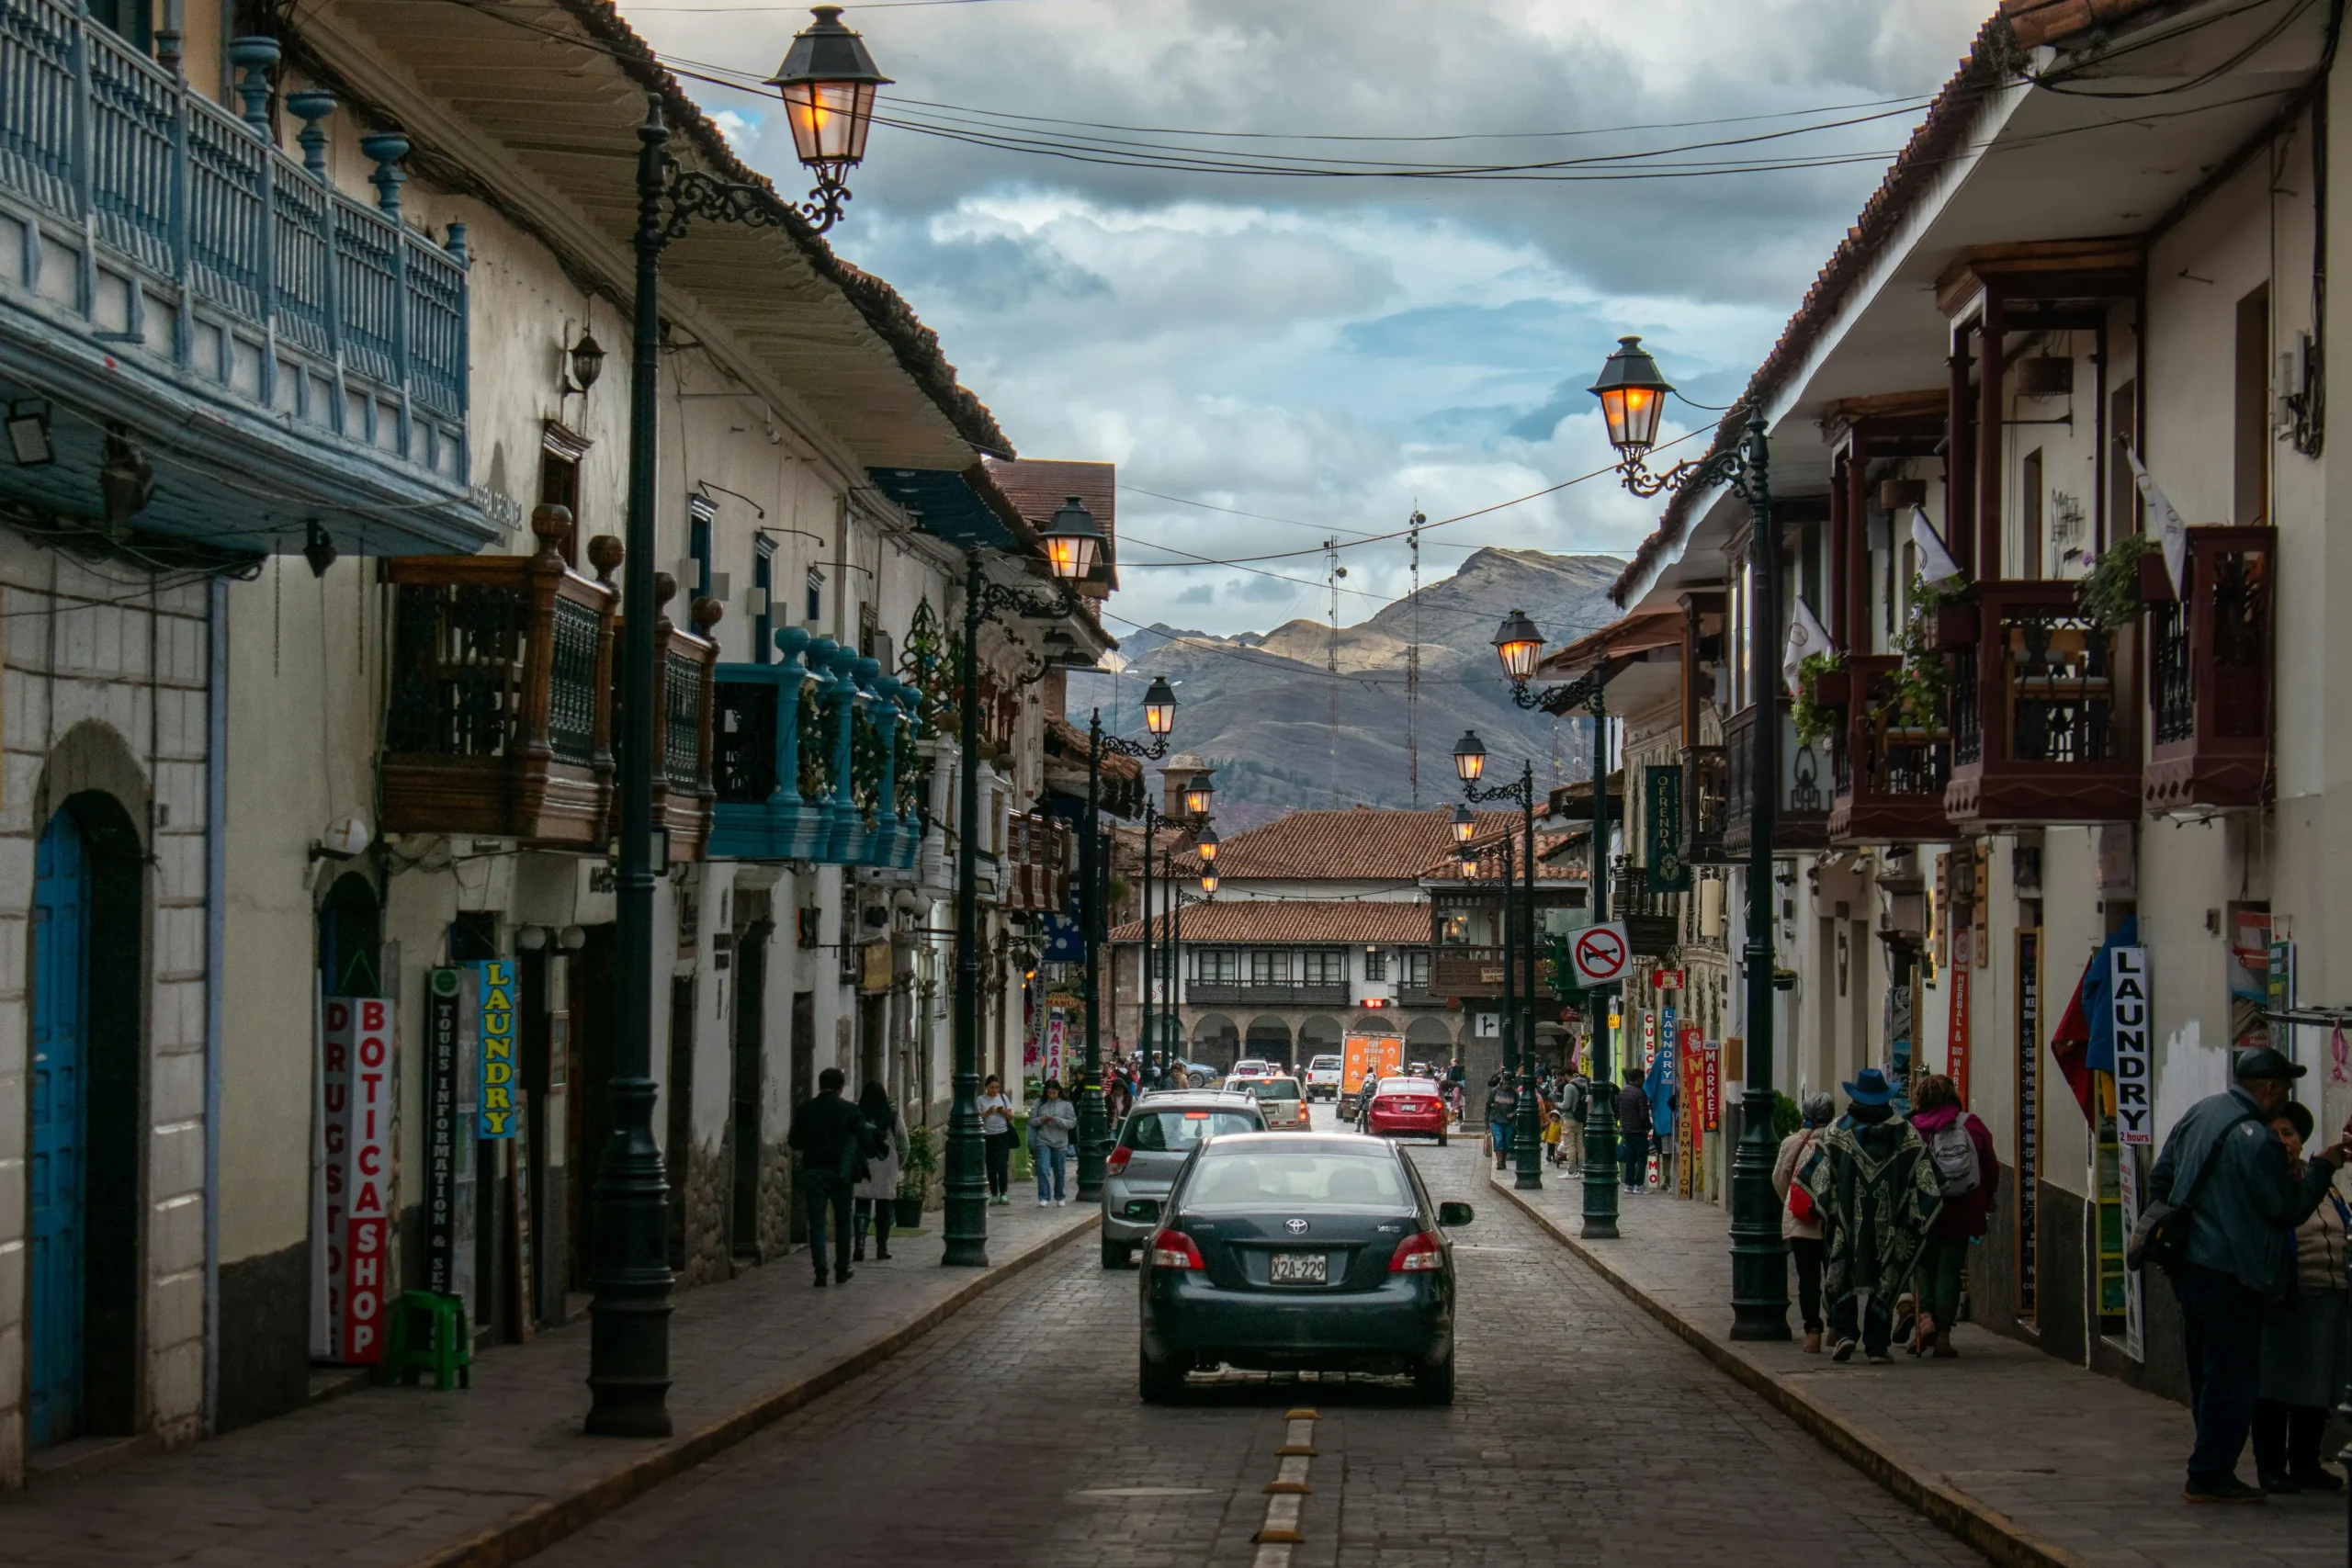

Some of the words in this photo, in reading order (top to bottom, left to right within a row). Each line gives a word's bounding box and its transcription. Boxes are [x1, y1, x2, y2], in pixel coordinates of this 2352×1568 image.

[1657, 776, 1669, 849] OFRENDA
[1046, 998, 1074, 1008] MANU
[1955, 975, 1965, 1027] HERBAL
[435, 1004, 453, 1072] TOURS
[484, 963, 514, 1134] LAUNDRY
[1664, 1010, 1673, 1078] LAUNDRY
[1951, 1046, 1964, 1056] BIO
[1954, 1030, 1962, 1043] &
[2115, 952, 2148, 1131] LAUNDRY
[355, 1000, 386, 1213] BOTICA
[1705, 1051, 1717, 1120] MARKET
[432, 1077, 451, 1226] INFORMATION
[1680, 1093, 1691, 1195] INFORMATION
[2120, 1132, 2126, 1142] 2
[2127, 1132, 2150, 1143] hours
[432, 1234, 447, 1248] &
[1272, 1261, 1325, 1278] X2A-229
[353, 1223, 379, 1355] SHOP
